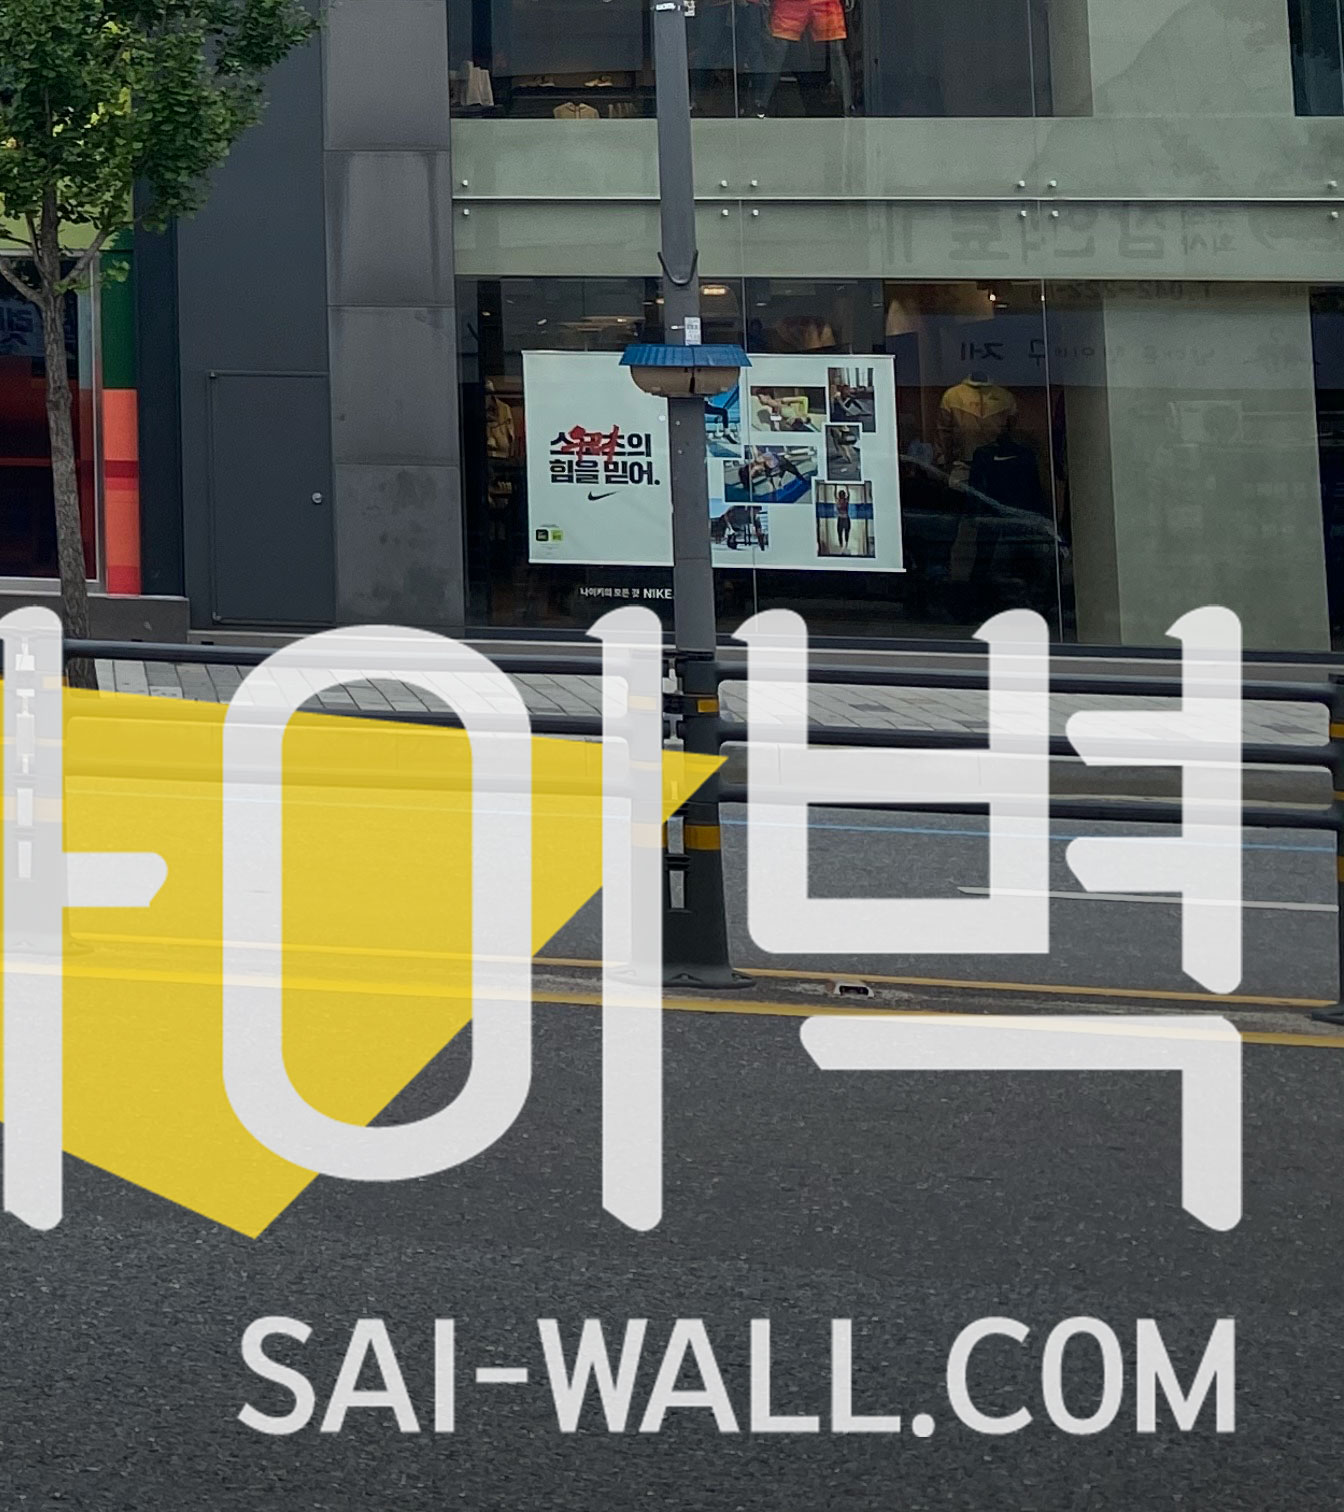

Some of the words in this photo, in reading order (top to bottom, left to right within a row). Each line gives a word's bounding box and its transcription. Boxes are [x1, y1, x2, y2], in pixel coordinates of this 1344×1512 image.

[549, 459, 600, 484] 힘을
[604, 461, 661, 486] 믿어.
[643, 588, 673, 599] NIKE
